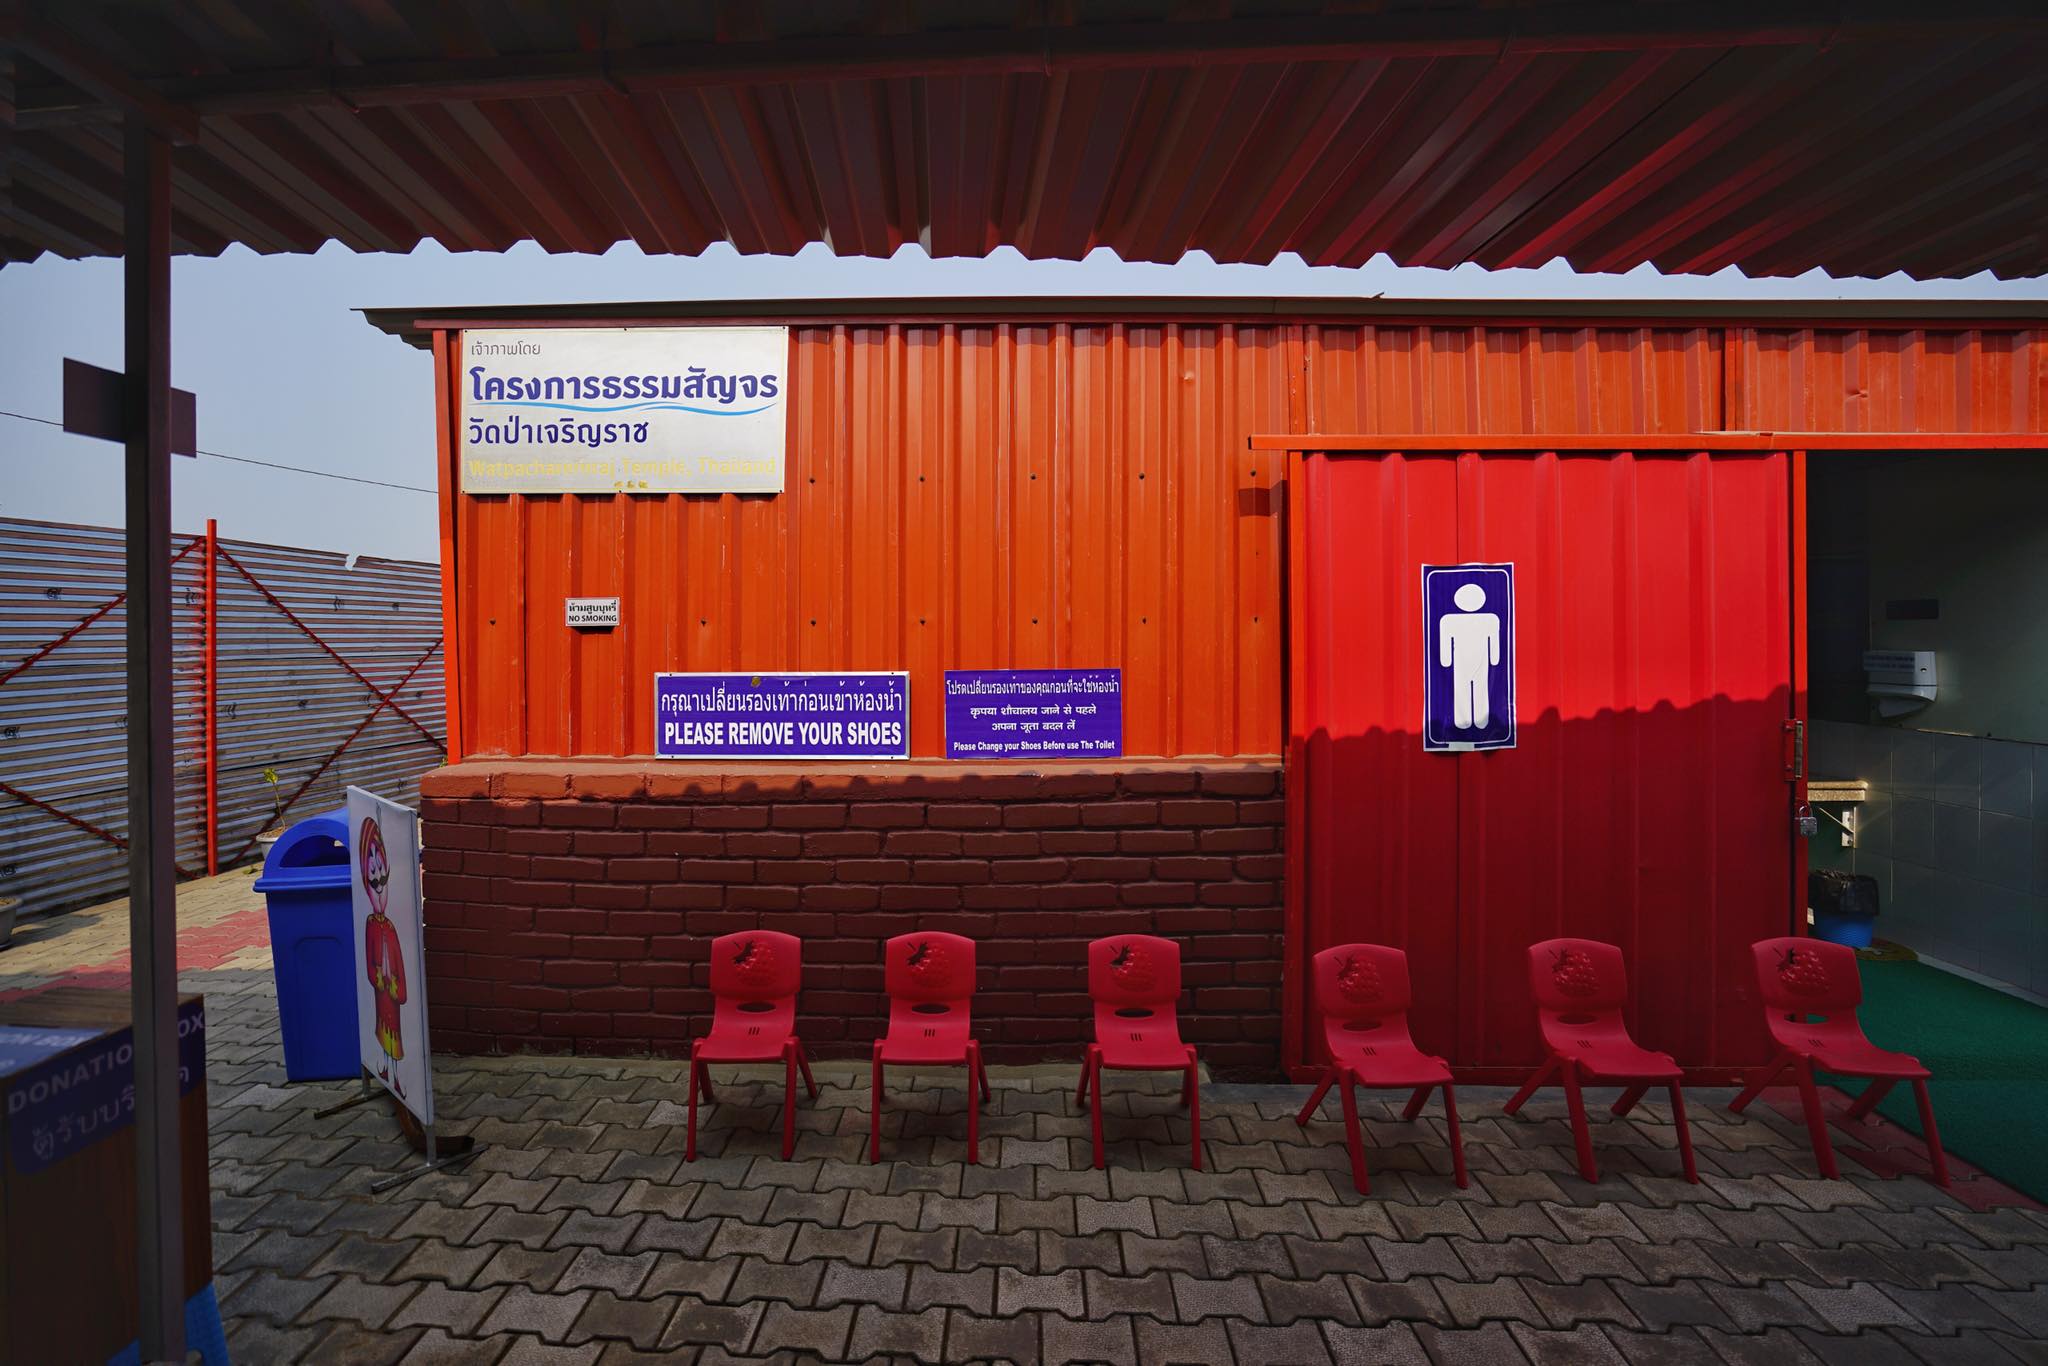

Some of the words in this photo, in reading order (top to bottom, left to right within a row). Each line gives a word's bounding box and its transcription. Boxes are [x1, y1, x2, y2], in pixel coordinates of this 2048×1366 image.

[471, 340, 541, 356] เจ้าภาพโดย
[469, 366, 778, 404] โครงการธรรมสัญจร
[469, 416, 649, 447] วัดป่าเจริญราช
[569, 600, 616, 614] ห้ามสูบบุหรี่
[947, 675, 1119, 696] โปรดเปลี่ยนรองเท้าของคุณก่อนที่จะใช้ห้องน้ำ
[661, 680, 902, 717] กรุณาเปลี่ยนรองเท้าก่อนเข้าห้องน้ำ
[970, 707, 997, 719] कृपया
[1000, 704, 1038, 715] शौचालय
[1041, 704, 1060, 715] जाने
[1063, 704, 1072, 715] से
[1075, 703, 1097, 715] पहले
[665, 722, 724, 745] PLEASE
[728, 722, 794, 745] REMOVE
[798, 722, 842, 745] YOUR
[847, 722, 902, 745] SHOES
[991, 722, 1017, 731] अपना
[1020, 722, 1039, 734] जूता
[1042, 722, 1064, 731] बदल
[1066, 719, 1077, 730] लें
[953, 741, 976, 751] Please
[977, 741, 1003, 753] Change
[1004, 742, 1020, 752] your
[1021, 741, 1042, 750] Shoes
[1043, 741, 1067, 750] Before
[1067, 742, 1079, 750] use
[1081, 740, 1094, 750] The
[1095, 740, 1116, 750] Toilet
[7, 1044, 133, 1115] DONATIO
[178, 1011, 204, 1039] OX
